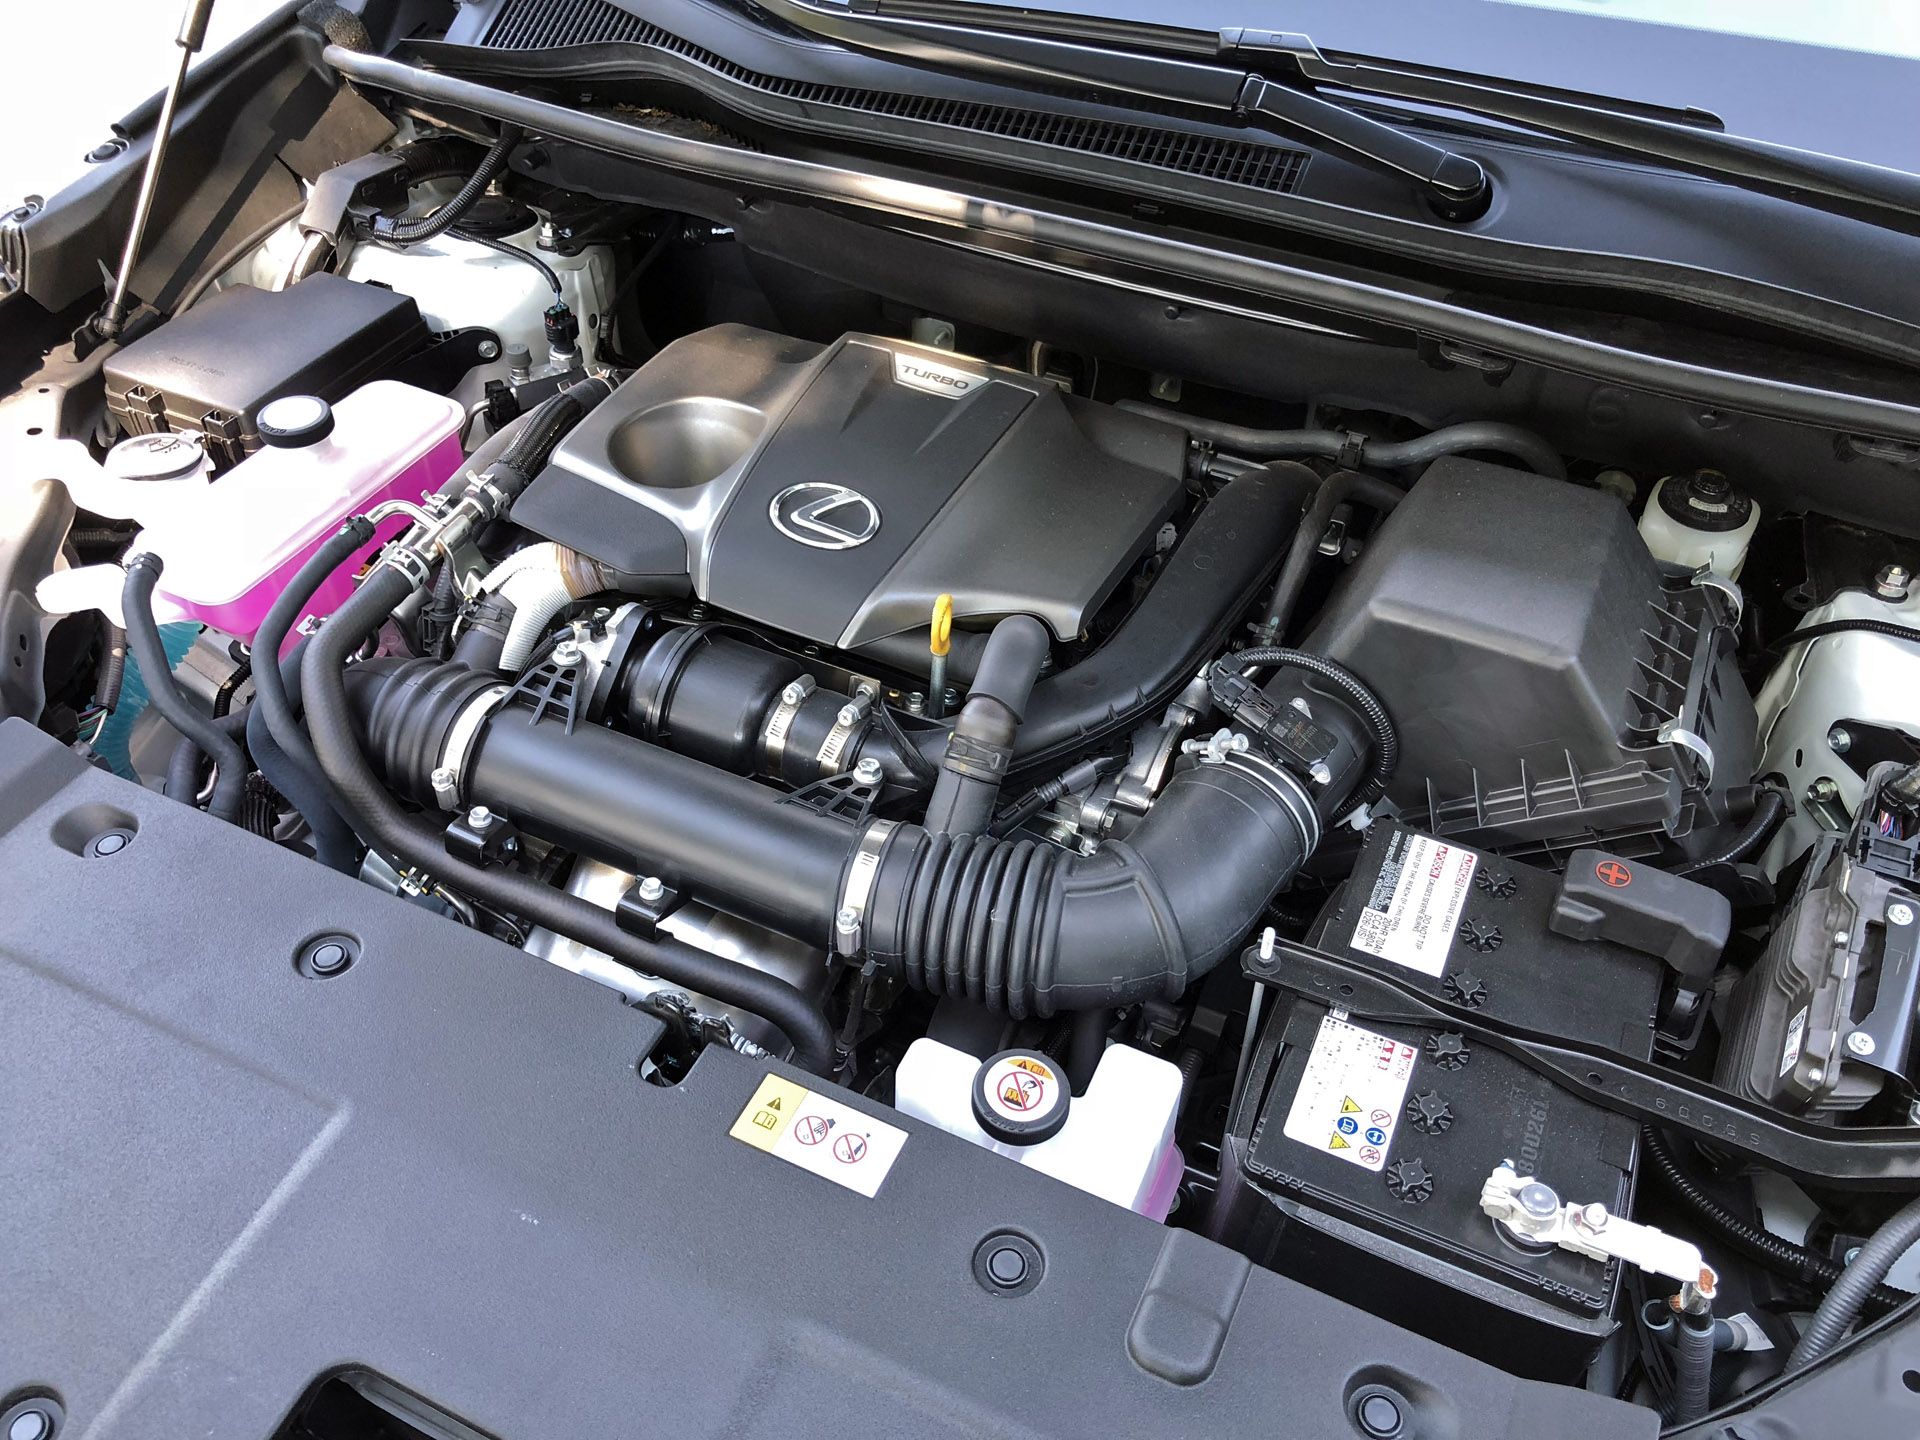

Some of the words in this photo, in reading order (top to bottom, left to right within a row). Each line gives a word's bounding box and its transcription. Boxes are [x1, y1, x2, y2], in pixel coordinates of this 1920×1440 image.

[901, 365, 969, 389] TURBO
[1417, 838, 1427, 851] KEEP
[1411, 860, 1419, 869] OF
[1413, 850, 1422, 862] OUT
[1429, 851, 1446, 877] POISON
[1407, 868, 1416, 879] THE
[1455, 859, 1471, 886] DANGER
[1401, 879, 1413, 897] REACH
[1423, 877, 1435, 897] CAUSES
[1417, 896, 1429, 915] SEVERE
[1446, 886, 1461, 914] EXPLOSIVE
[1370, 913, 1382, 930] CCA
[1378, 916, 1392, 936] 20HR
[1389, 904, 1405, 932] CHILDREN
[1411, 914, 1423, 932] BURNS
[1422, 914, 1432, 925] DO
[1440, 914, 1452, 933] GASES
[1364, 929, 1377, 948] 580A
[1417, 924, 1428, 938] NOT
[1372, 936, 1385, 954] 70Ah
[1414, 939, 1424, 950] TIP
